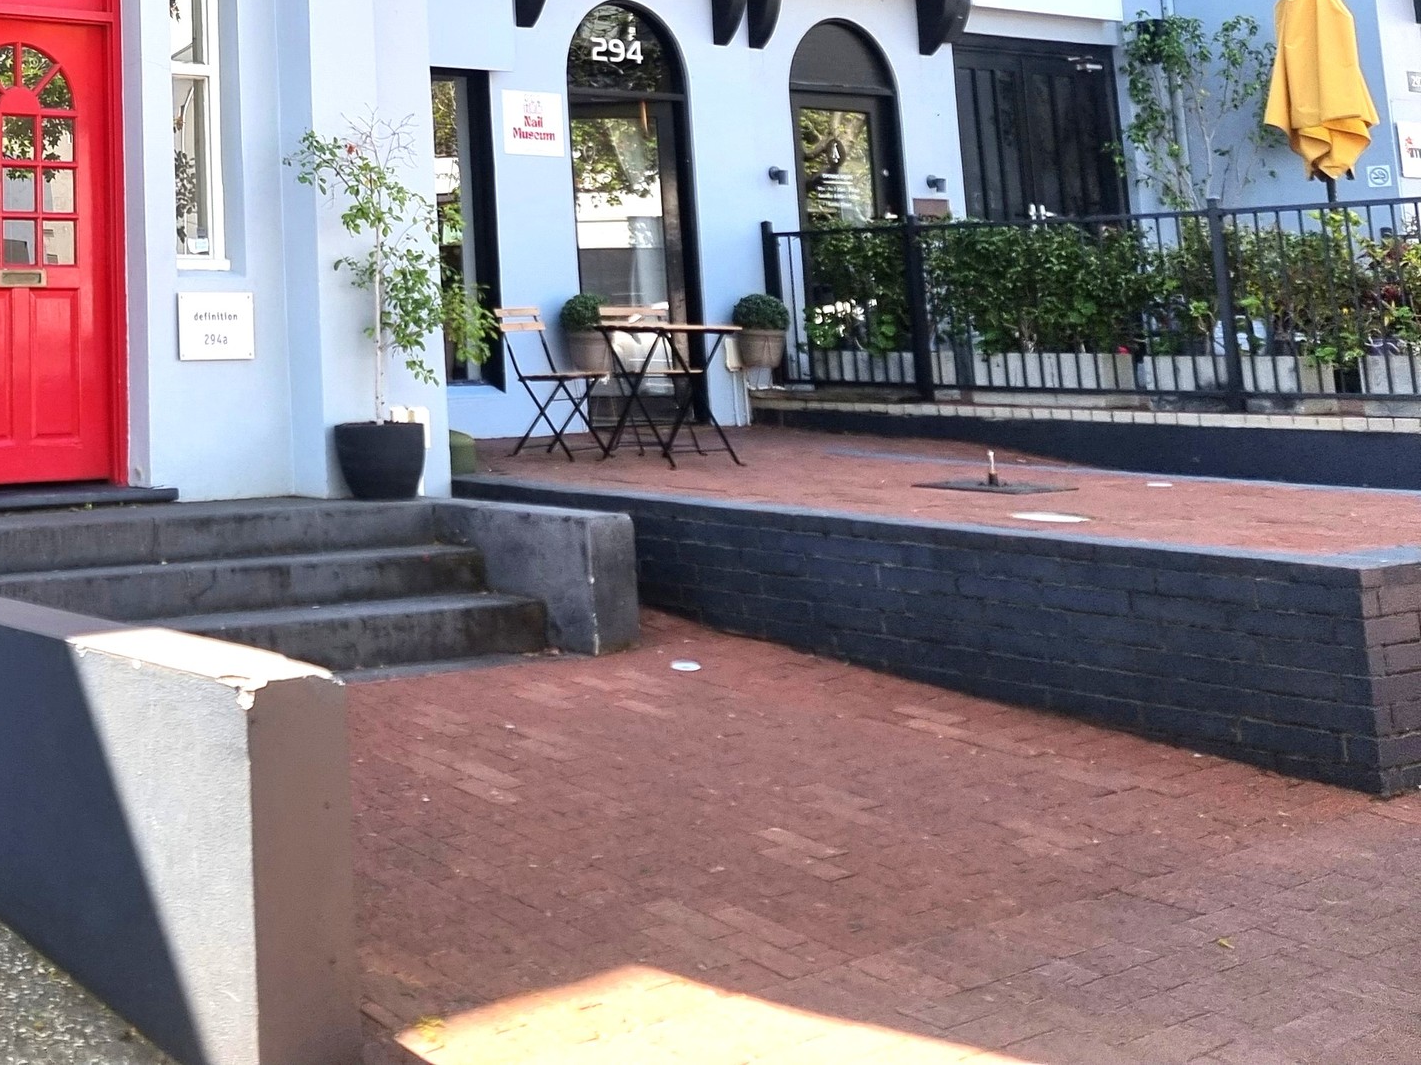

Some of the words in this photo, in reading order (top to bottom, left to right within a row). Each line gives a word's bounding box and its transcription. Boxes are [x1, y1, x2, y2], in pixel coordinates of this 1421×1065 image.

[590, 36, 644, 65] 294
[523, 115, 544, 128] Nail
[193, 312, 238, 321] definition
[204, 334, 228, 345] 294a
